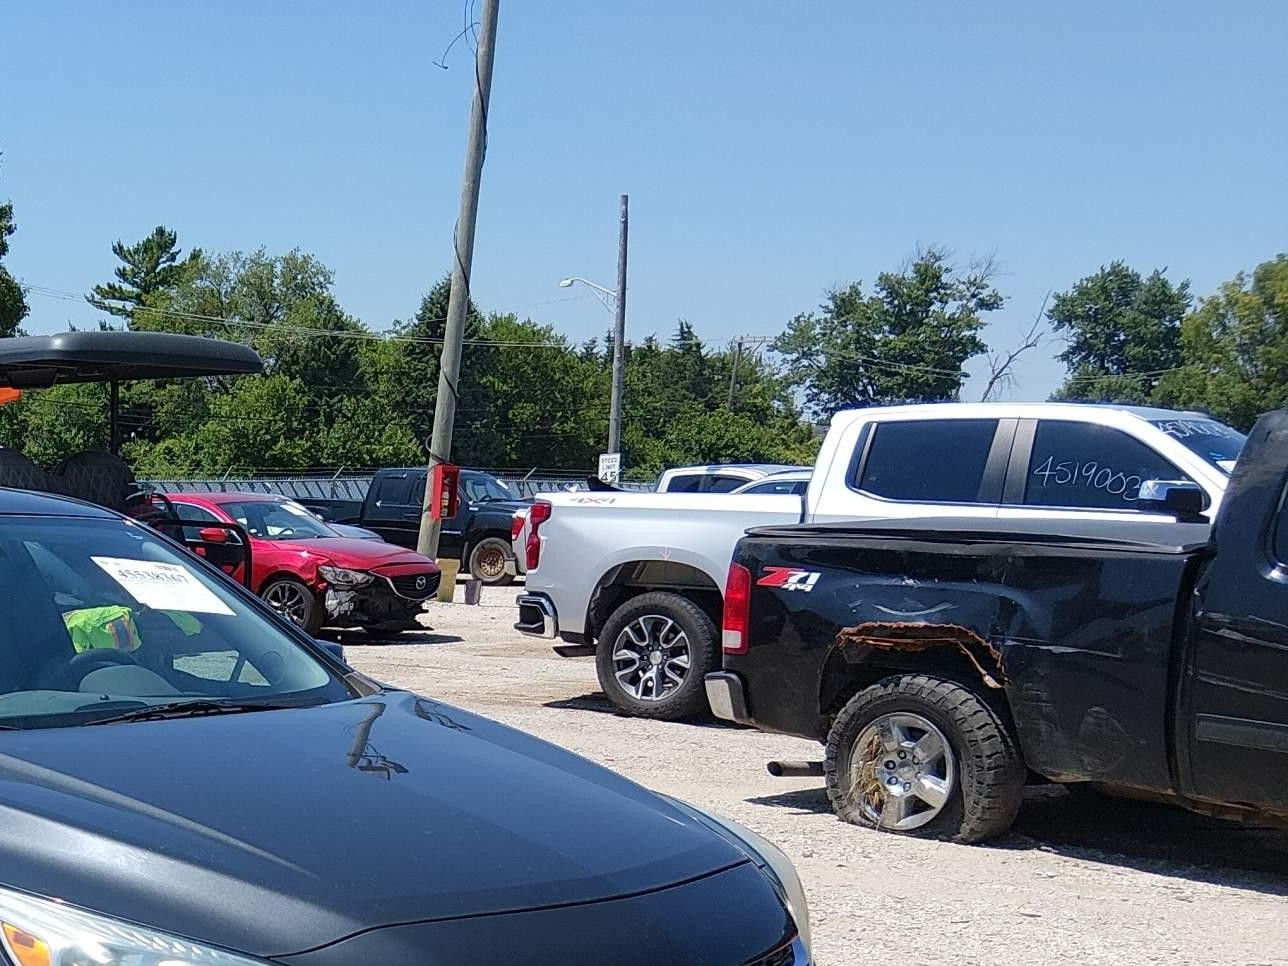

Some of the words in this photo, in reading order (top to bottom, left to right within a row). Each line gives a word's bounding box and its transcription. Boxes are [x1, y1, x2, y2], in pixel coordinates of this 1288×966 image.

[600, 471, 617, 482] 45
[118, 569, 190, 584] 45538367
[757, 566, 822, 587] Z71
